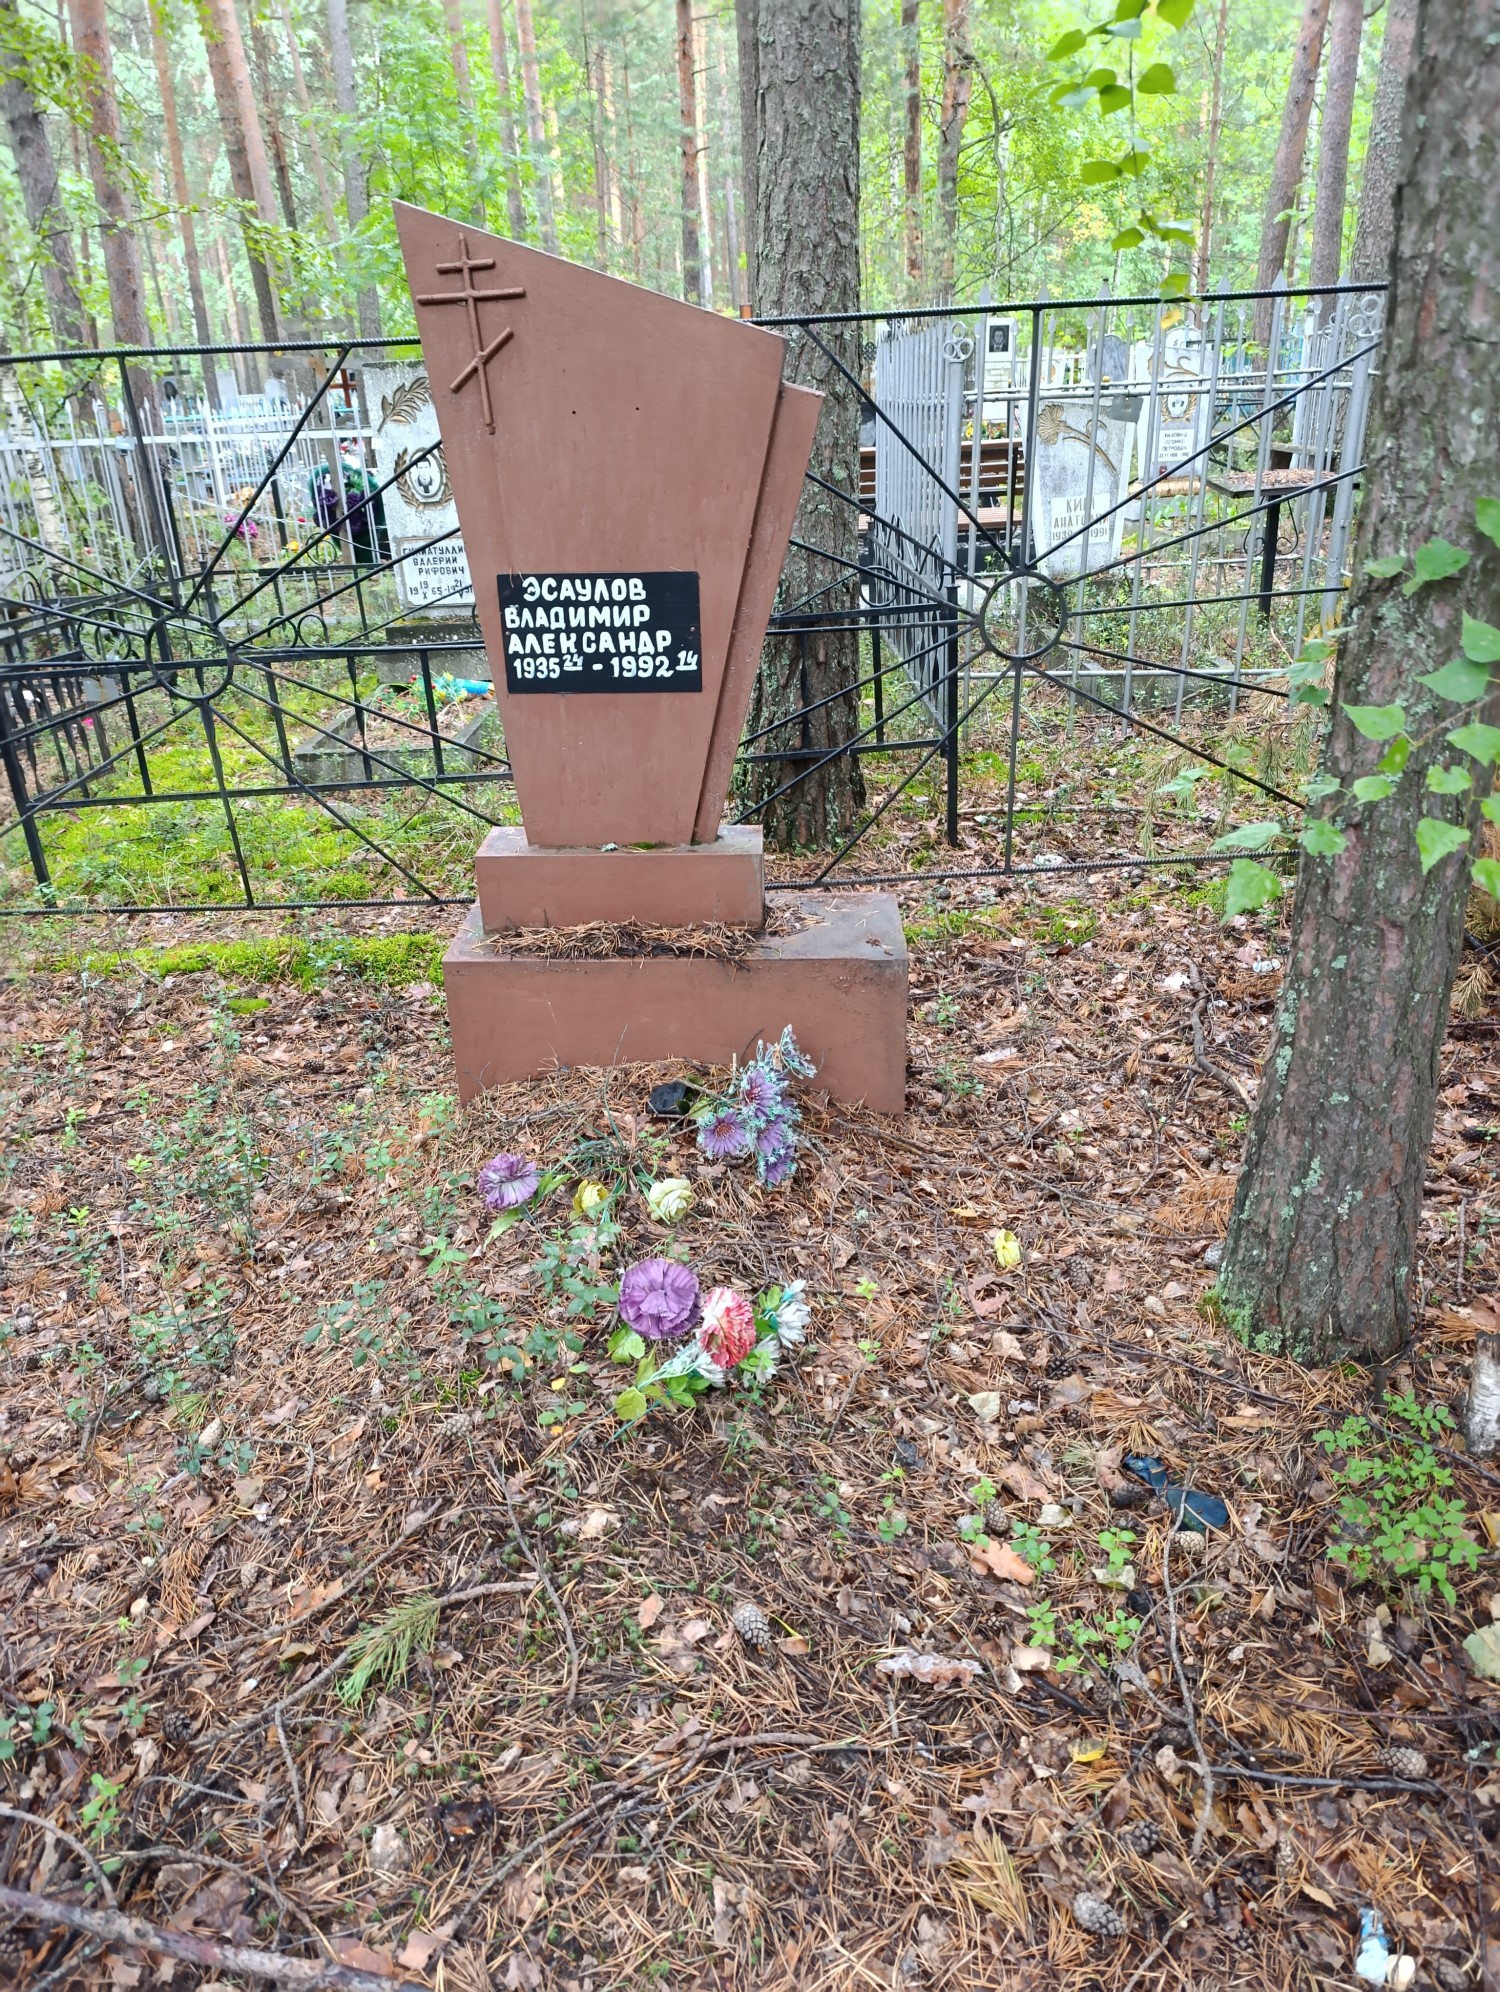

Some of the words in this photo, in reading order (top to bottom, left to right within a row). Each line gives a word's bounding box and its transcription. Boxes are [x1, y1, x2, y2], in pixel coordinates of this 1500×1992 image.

[1091, 527, 1107, 538] 1991
[418, 566, 465, 576] РИФОВИЧ
[522, 577, 646, 602] ЭСАУЛОВ
[505, 604, 650, 629] ВЛАДИМИР
[508, 630, 672, 655] АЛЕКСАНДР
[513, 657, 560, 679] 1935
[610, 655, 674, 678] 1992
